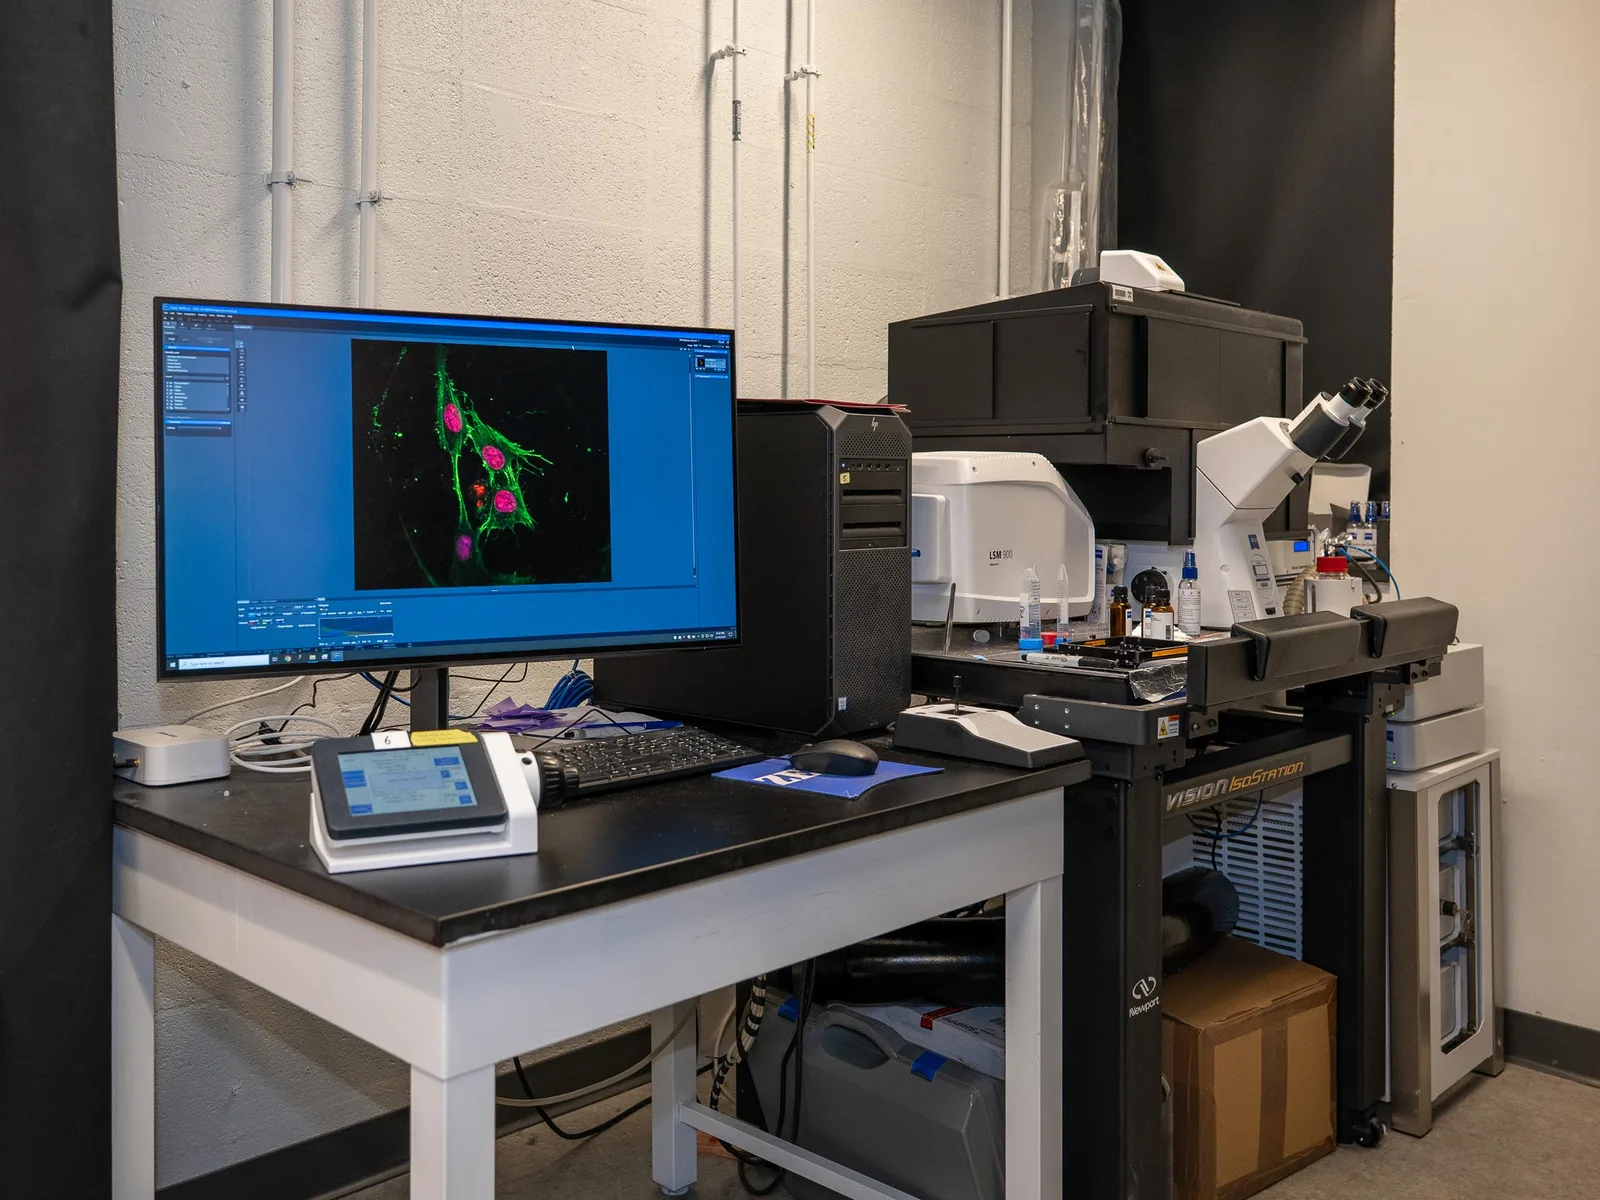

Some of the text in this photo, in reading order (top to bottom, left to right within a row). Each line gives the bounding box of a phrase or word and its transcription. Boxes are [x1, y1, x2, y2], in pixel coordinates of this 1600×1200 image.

[989, 549, 1013, 560] LSM 900
[384, 735, 391, 745] 6
[1166, 778, 1229, 811] VISION
[1129, 996, 1160, 1018] Newport
